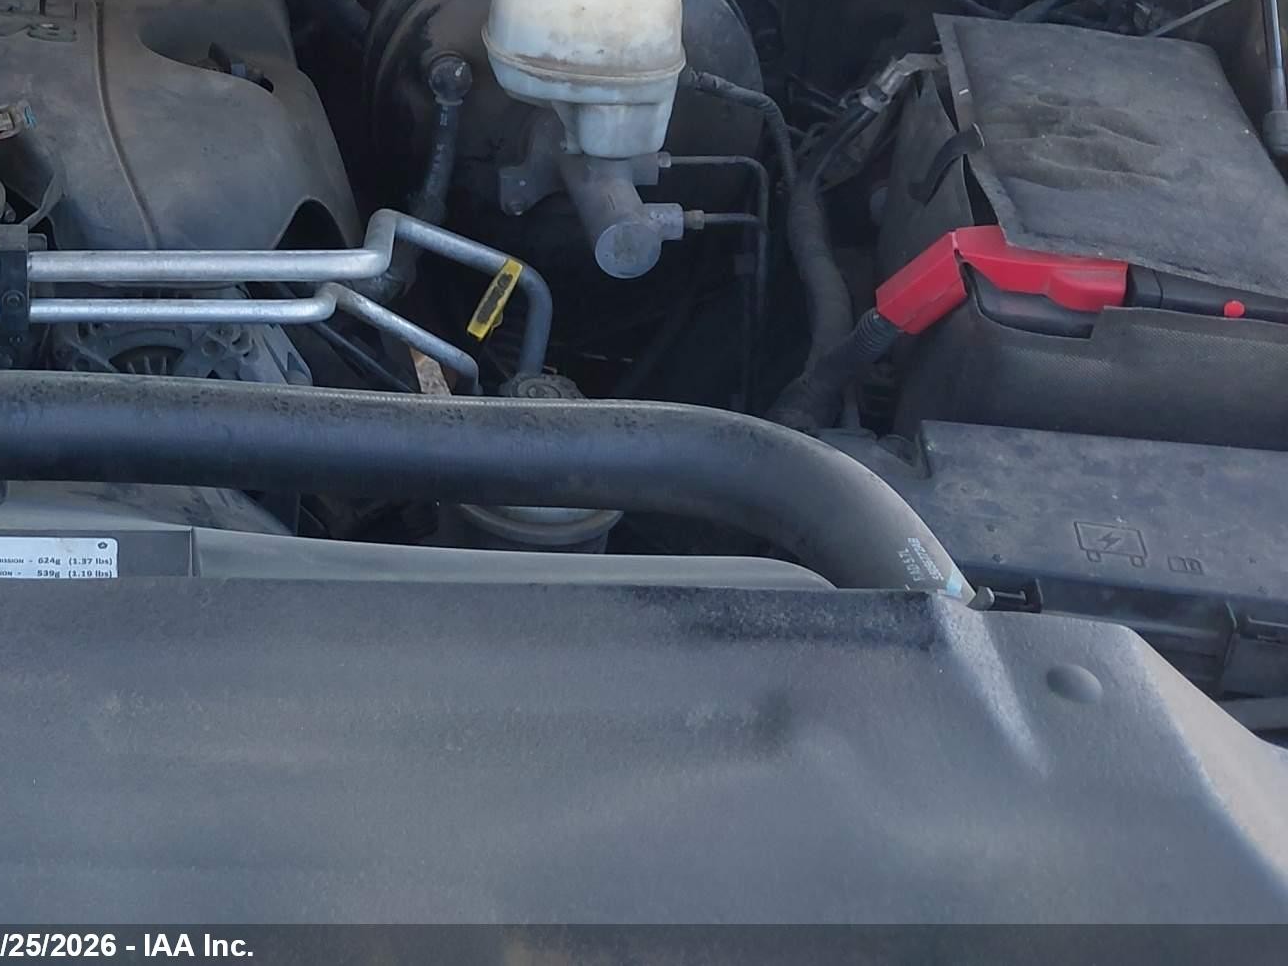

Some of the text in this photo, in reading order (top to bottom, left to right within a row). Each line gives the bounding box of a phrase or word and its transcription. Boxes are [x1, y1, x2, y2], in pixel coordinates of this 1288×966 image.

[38, 557, 61, 566] 624g
[68, 557, 93, 566] (1.37
[95, 557, 113, 566] lbs)
